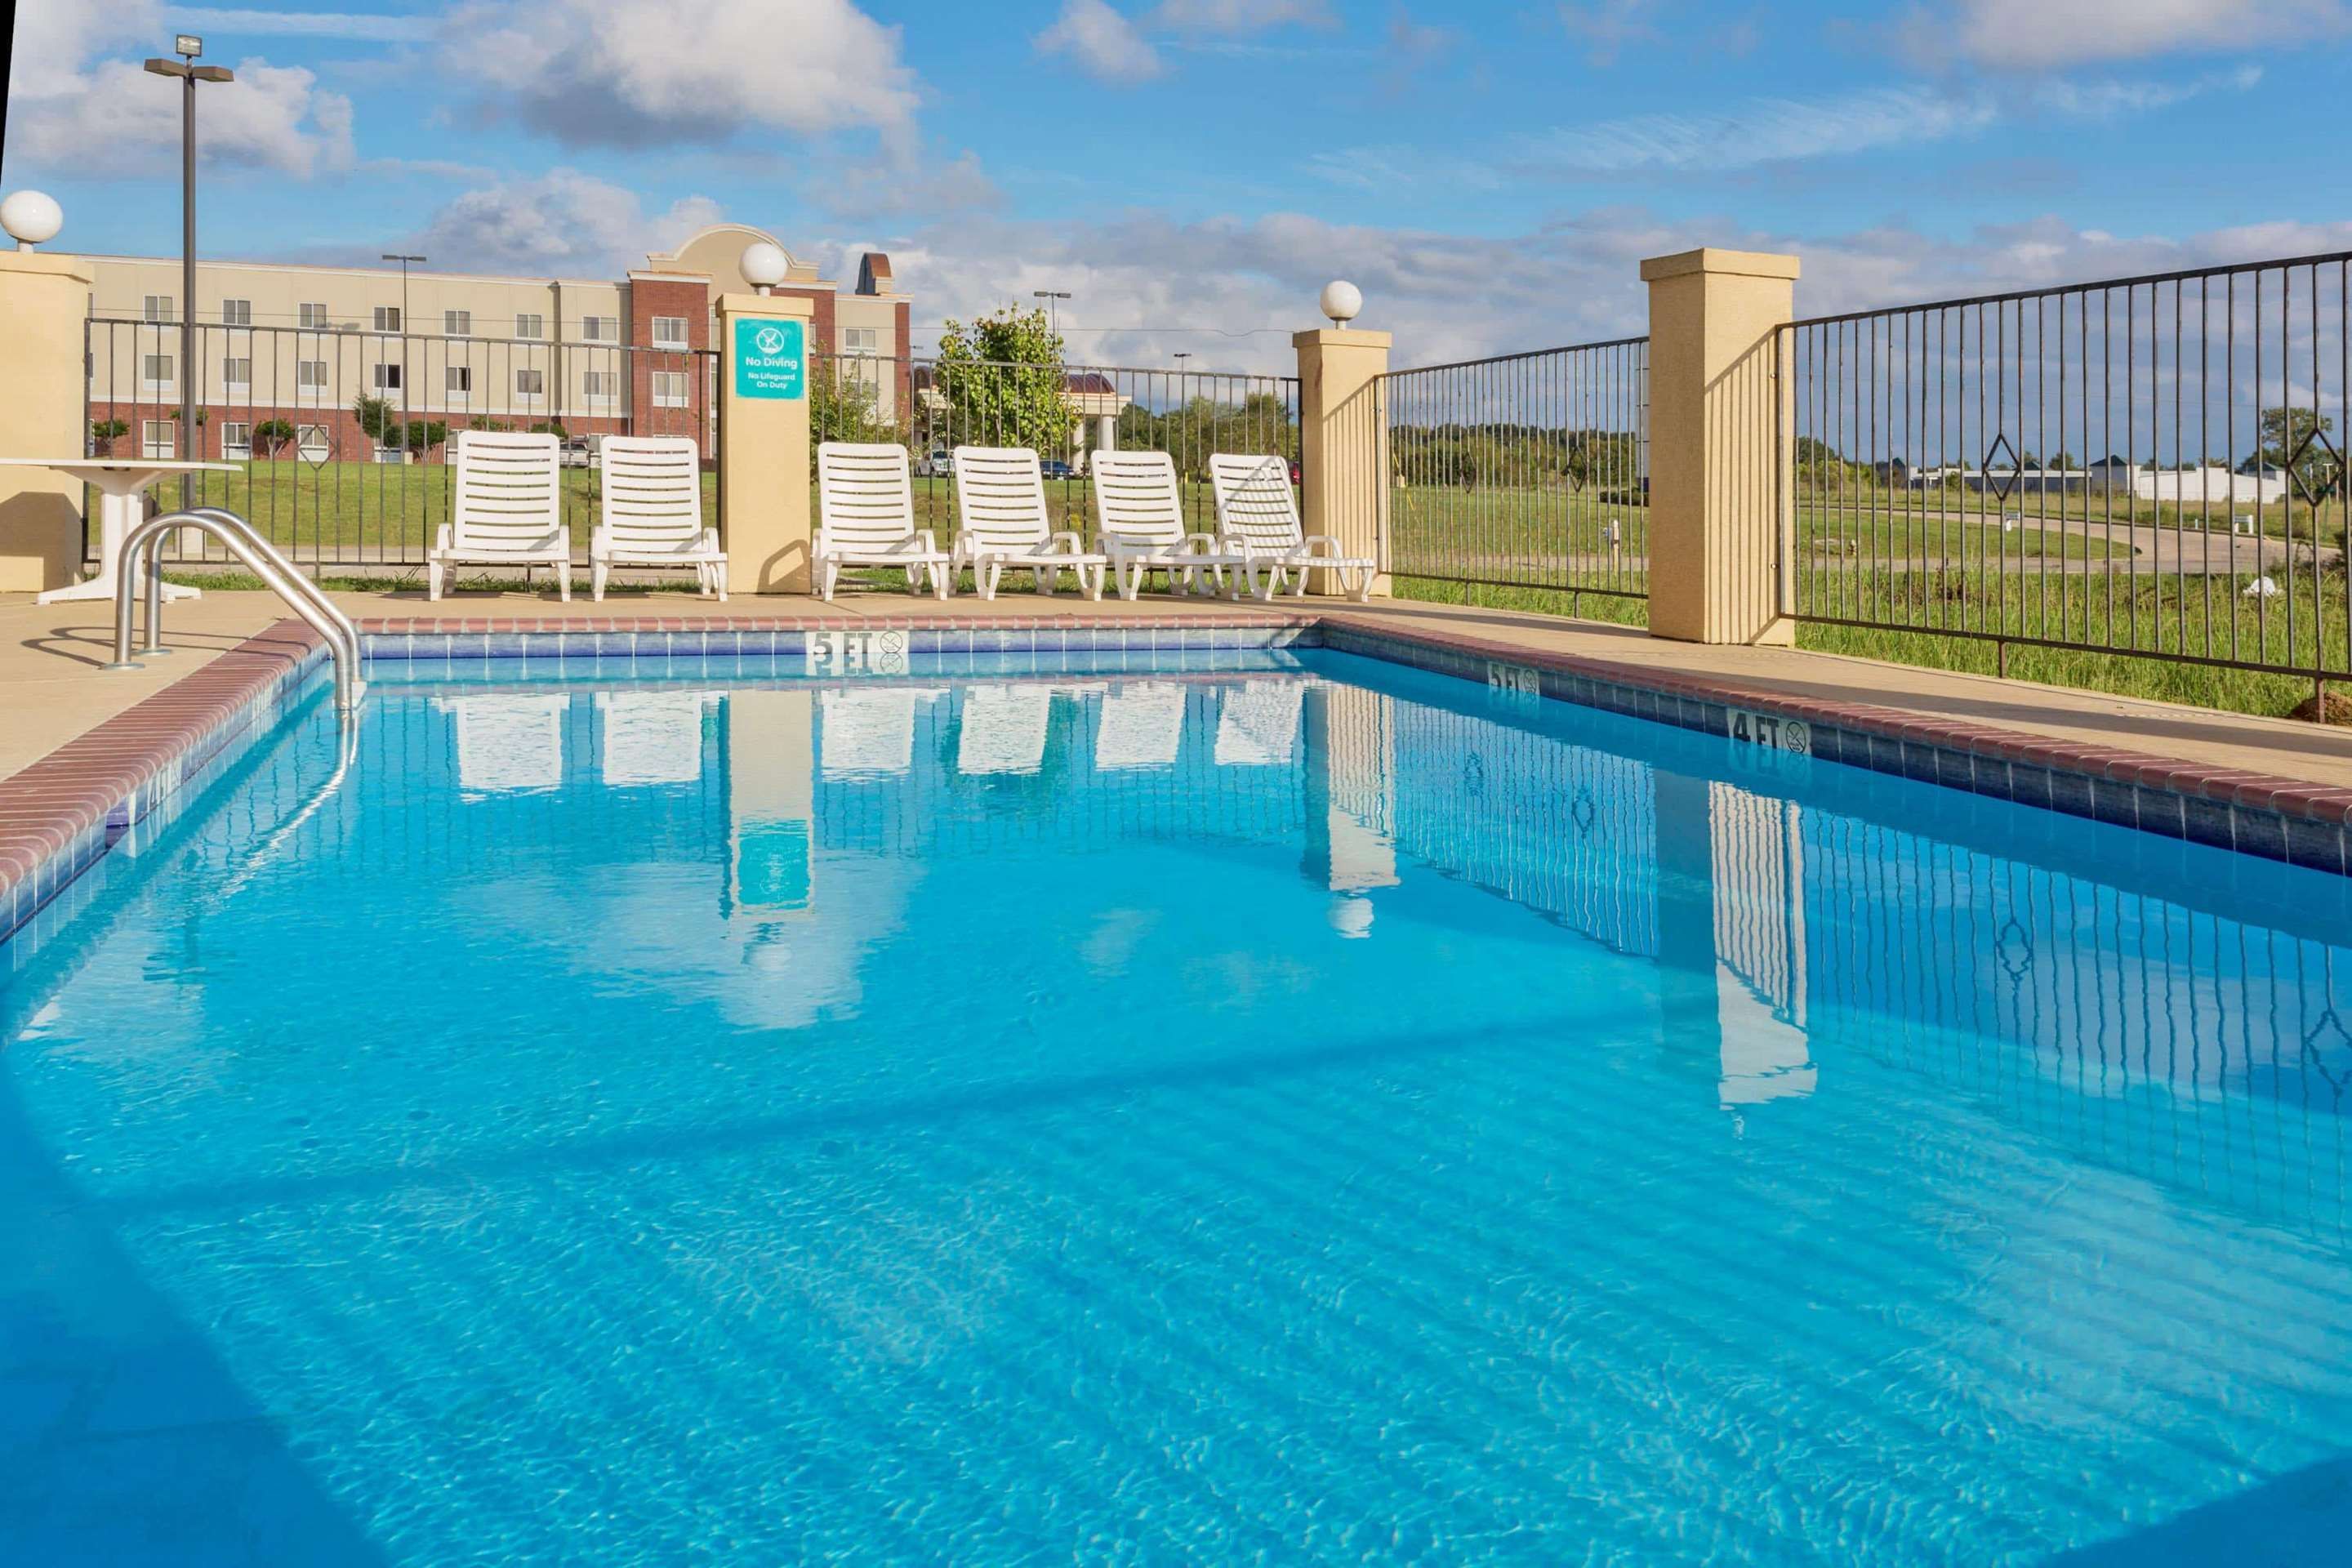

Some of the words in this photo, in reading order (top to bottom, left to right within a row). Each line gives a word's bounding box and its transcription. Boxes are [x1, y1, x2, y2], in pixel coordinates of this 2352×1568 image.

[746, 357, 760, 366] No
[764, 357, 798, 370] Diving
[760, 372, 795, 381] Lifeguard
[769, 381, 788, 390] Duty
[813, 632, 833, 654] 5
[844, 632, 872, 654] FT
[1491, 663, 1502, 687] 5
[1505, 666, 1521, 691] FT
[1732, 712, 1751, 742] 4
[1755, 715, 1780, 749] FT
